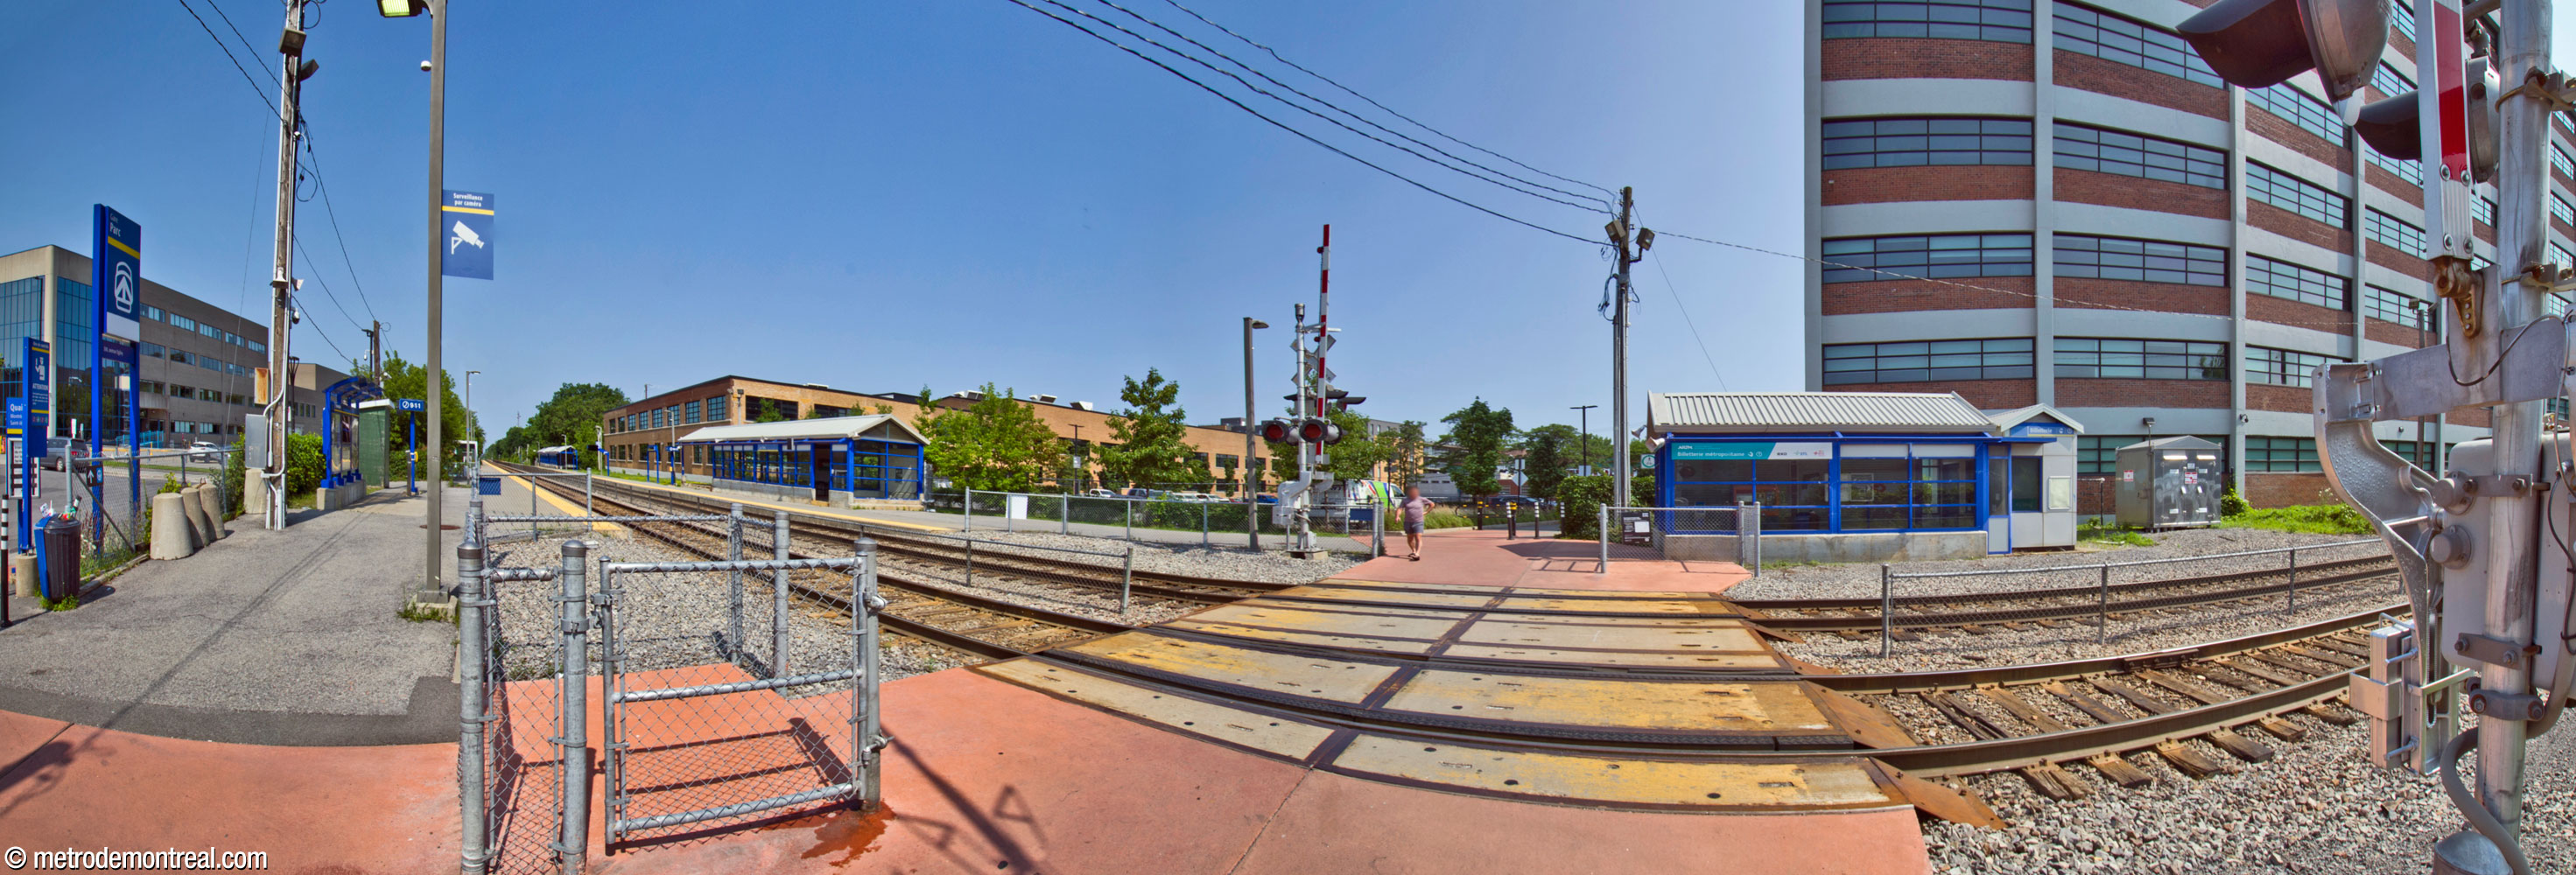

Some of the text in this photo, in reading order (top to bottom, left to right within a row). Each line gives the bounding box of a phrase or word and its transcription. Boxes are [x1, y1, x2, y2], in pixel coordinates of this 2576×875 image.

[453, 192, 483, 201] Surveillance
[109, 222, 121, 237] Parc
[10, 403, 23, 412] Quai
